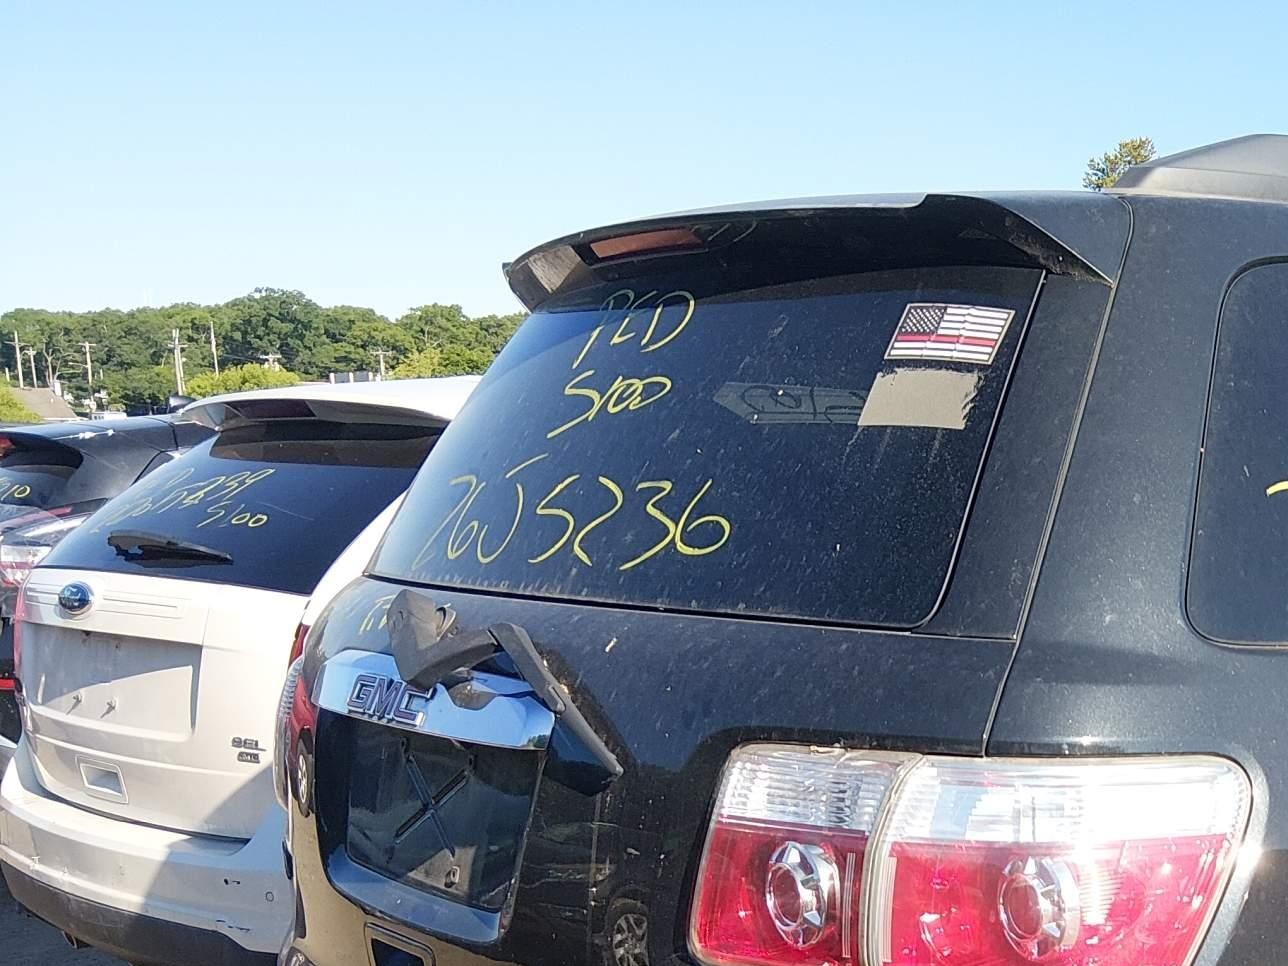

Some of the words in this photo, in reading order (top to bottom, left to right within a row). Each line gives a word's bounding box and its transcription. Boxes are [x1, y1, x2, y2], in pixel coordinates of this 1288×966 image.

[573, 289, 696, 368] PED
[545, 367, 672, 440] S100
[409, 451, 732, 571] 26J5236
[347, 672, 438, 728] GMC
